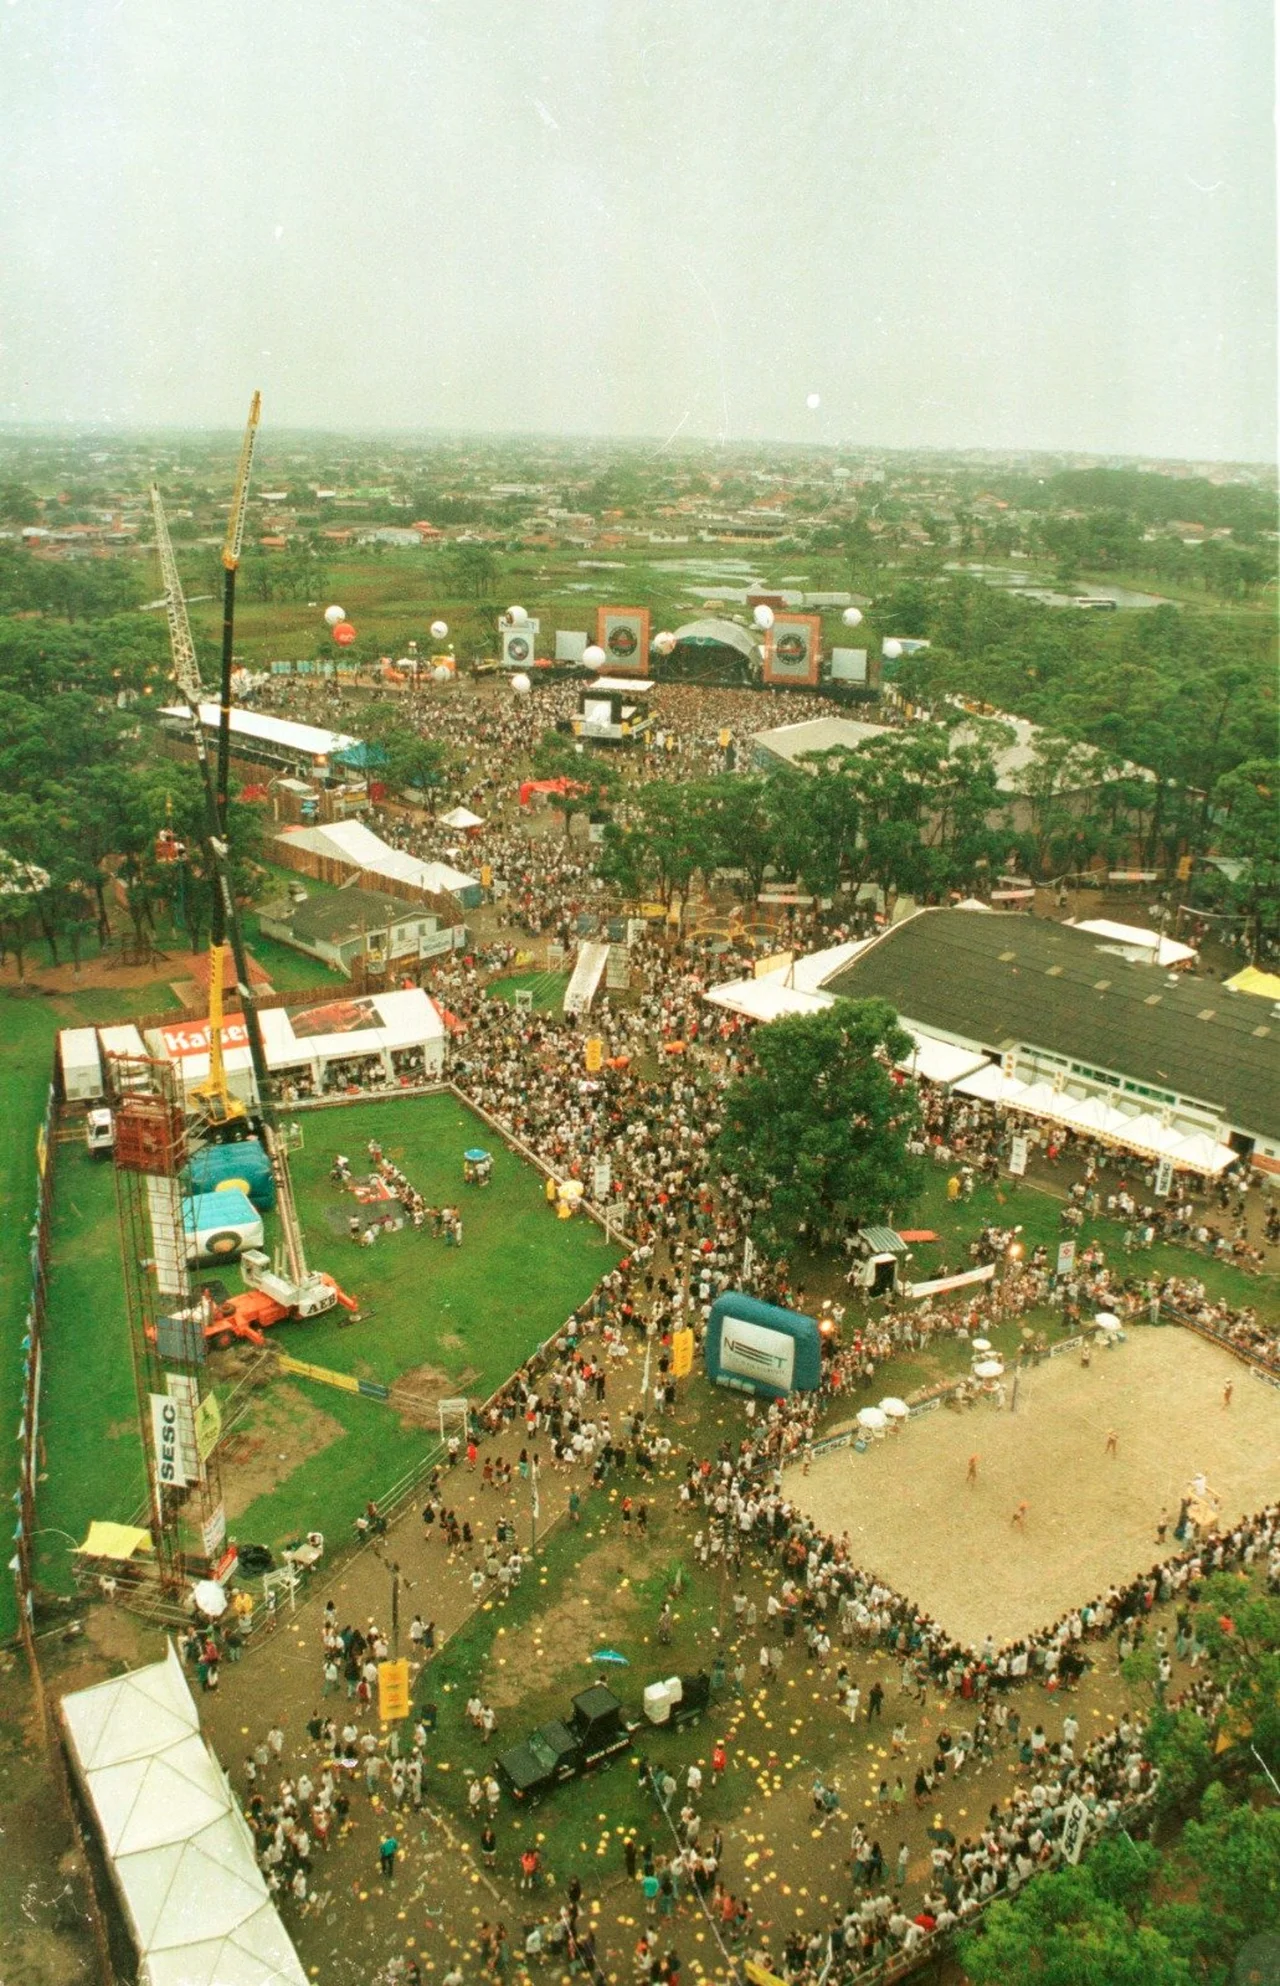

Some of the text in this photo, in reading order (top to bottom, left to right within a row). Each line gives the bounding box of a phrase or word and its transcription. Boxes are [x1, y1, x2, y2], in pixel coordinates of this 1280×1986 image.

[724, 1336, 788, 1369] NET
[161, 1403, 177, 1481] SESC
[1065, 1804, 1082, 1856] SESC
